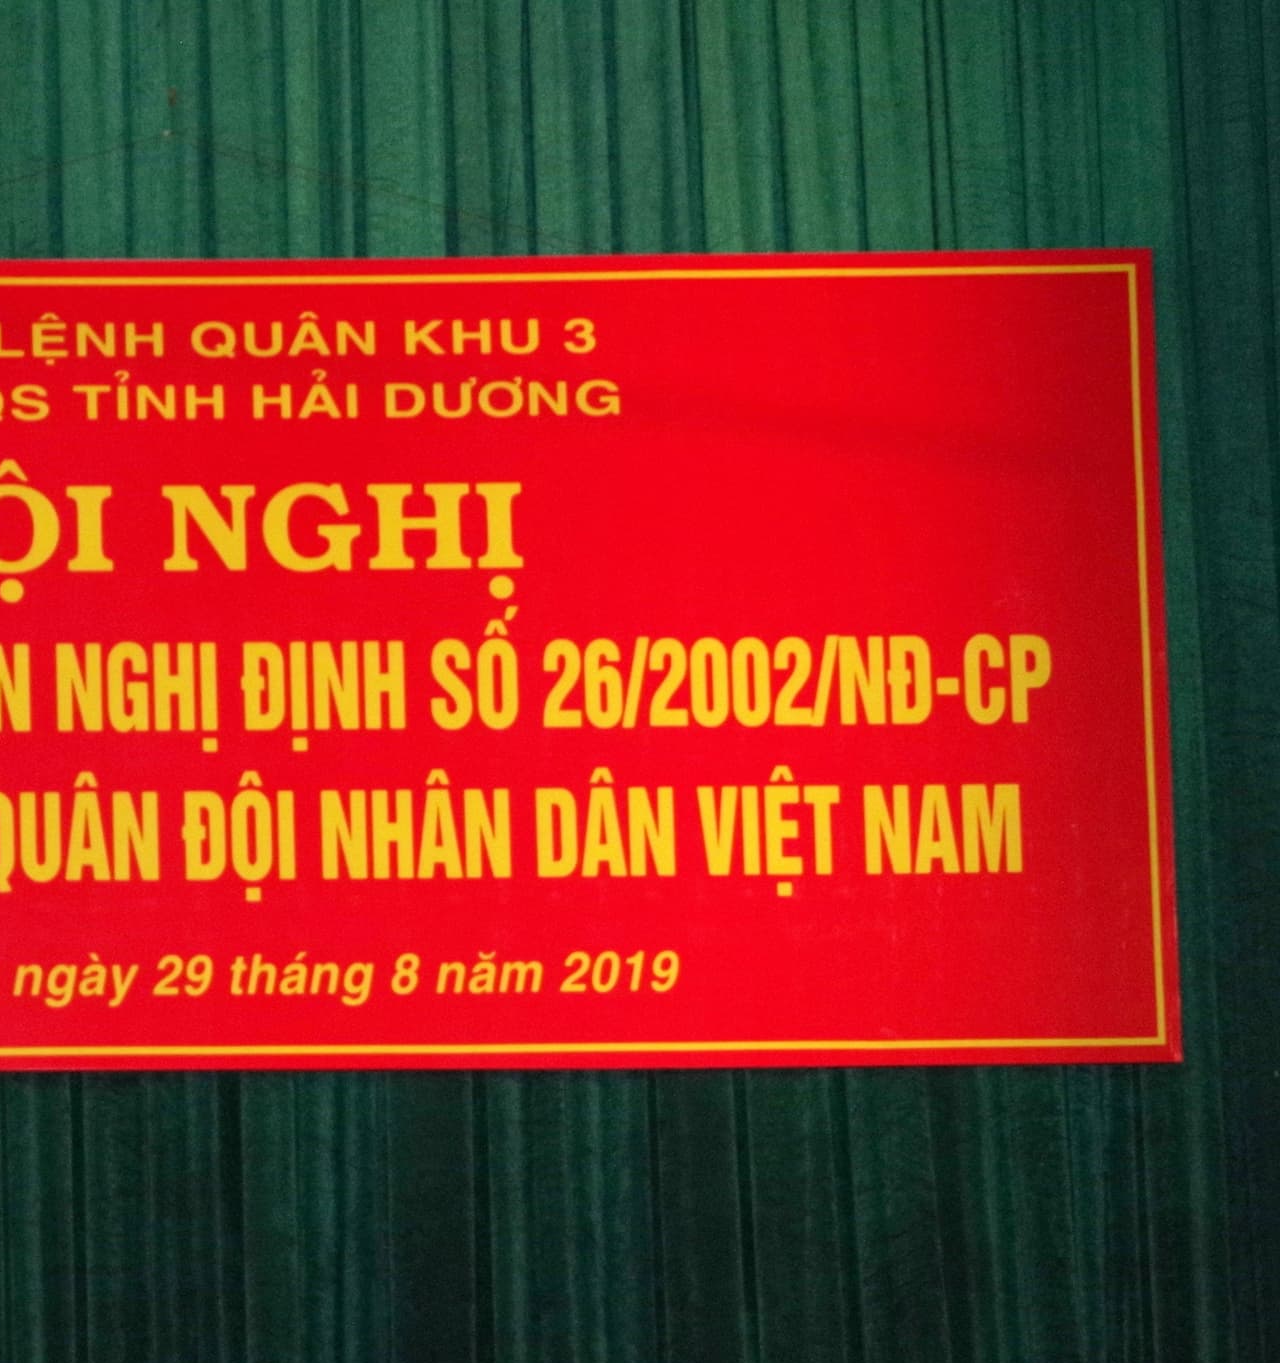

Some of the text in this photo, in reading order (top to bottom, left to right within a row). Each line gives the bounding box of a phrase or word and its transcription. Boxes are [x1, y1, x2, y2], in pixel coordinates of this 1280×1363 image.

[191, 310, 375, 357] QUÂN
[404, 318, 539, 355] KHU
[564, 318, 596, 354] 3
[73, 369, 224, 421] TỈNH
[252, 369, 358, 419] HẢI
[385, 376, 620, 418] DƯƠNG
[162, 482, 524, 599] NGHỊ
[55, 641, 219, 753] NGHỊ
[240, 640, 406, 752] ĐỊNH
[430, 604, 519, 730] SỐ
[543, 633, 1052, 729] 26/2002/NĐ-CP
[181, 769, 296, 902] ĐỘI
[320, 767, 512, 880] NHÂN
[535, 766, 676, 878] DÂN
[696, 764, 840, 897] VIỆT
[863, 783, 1023, 876] NAM
[13, 953, 139, 1008] ngày
[153, 953, 213, 997] 29
[230, 951, 374, 1007] tháng
[391, 953, 420, 995] 8
[436, 951, 543, 994] năm
[559, 949, 681, 993] 2019
